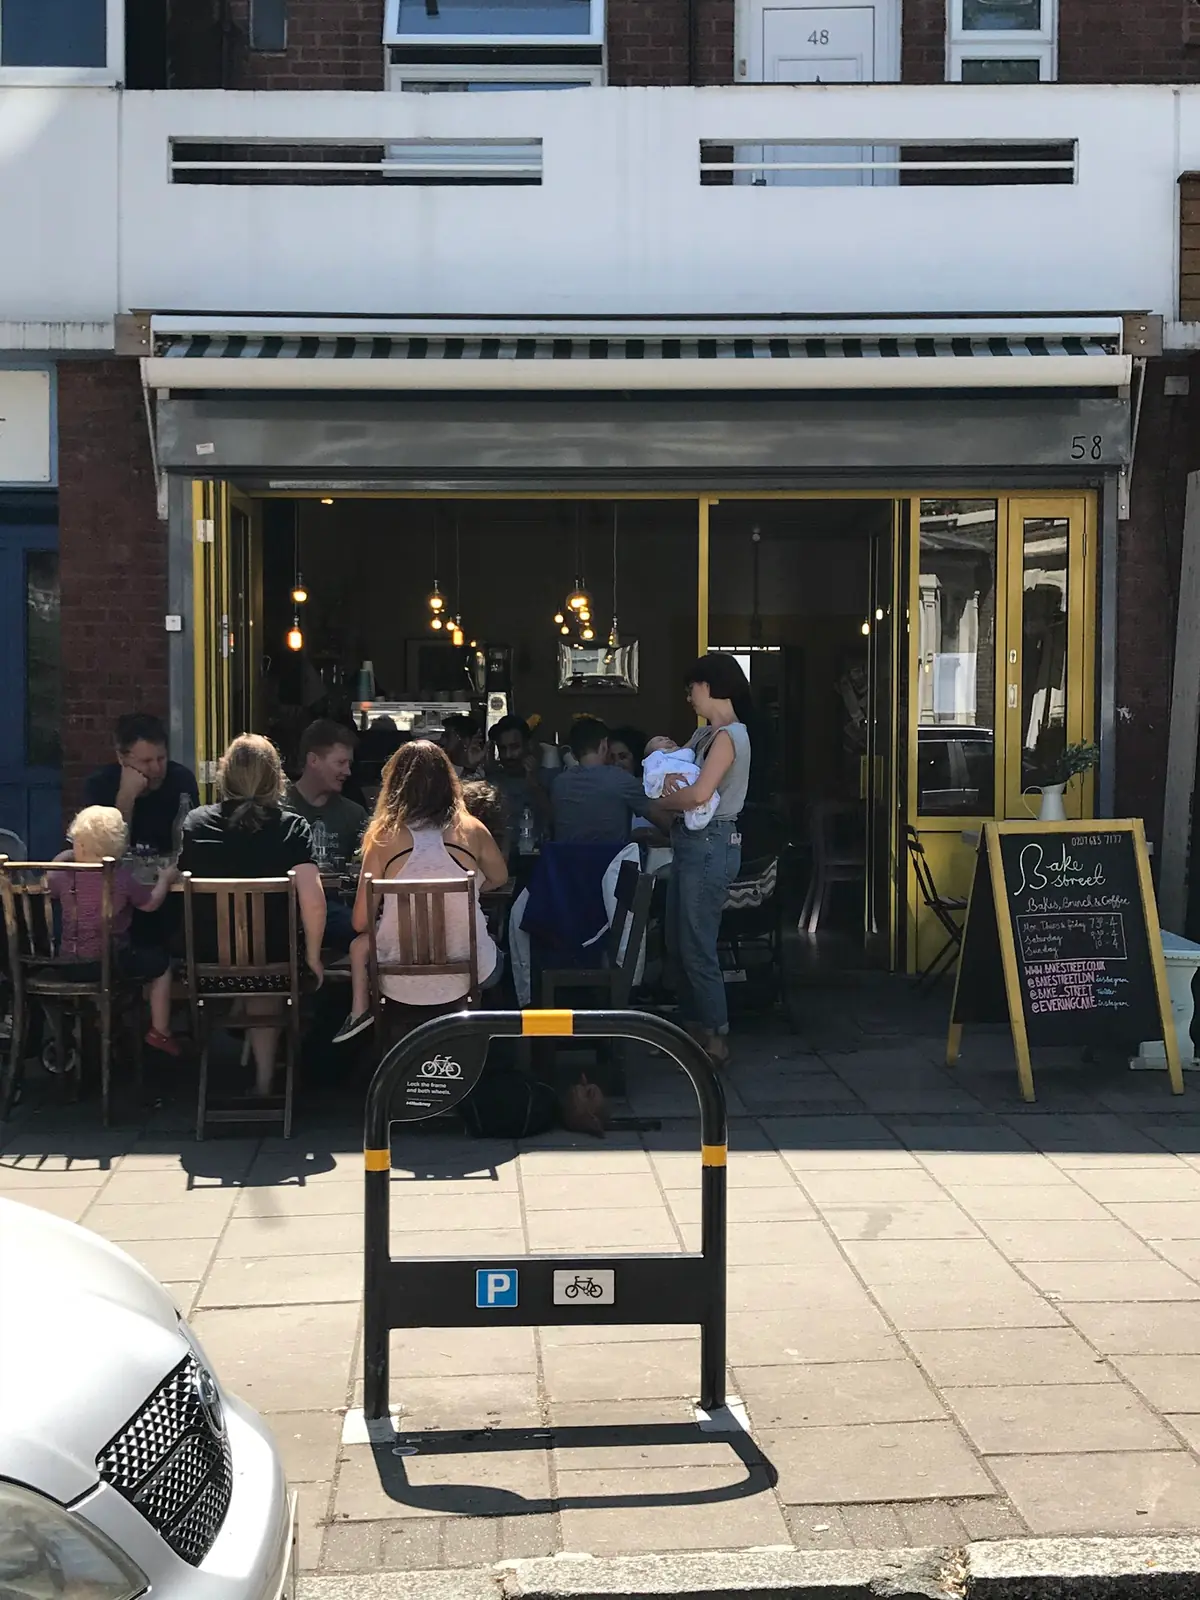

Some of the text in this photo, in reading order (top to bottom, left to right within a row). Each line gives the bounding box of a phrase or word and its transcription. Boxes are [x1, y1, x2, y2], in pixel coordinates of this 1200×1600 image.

[807, 29, 829, 45] 48
[1070, 435, 1102, 460] 58
[1013, 842, 1084, 896] Bake
[1050, 862, 1107, 888] street
[1101, 894, 1131, 910] Coffee
[1029, 983, 1093, 1000] @BAKE_STREET
[487, 1273, 511, 1304] P
